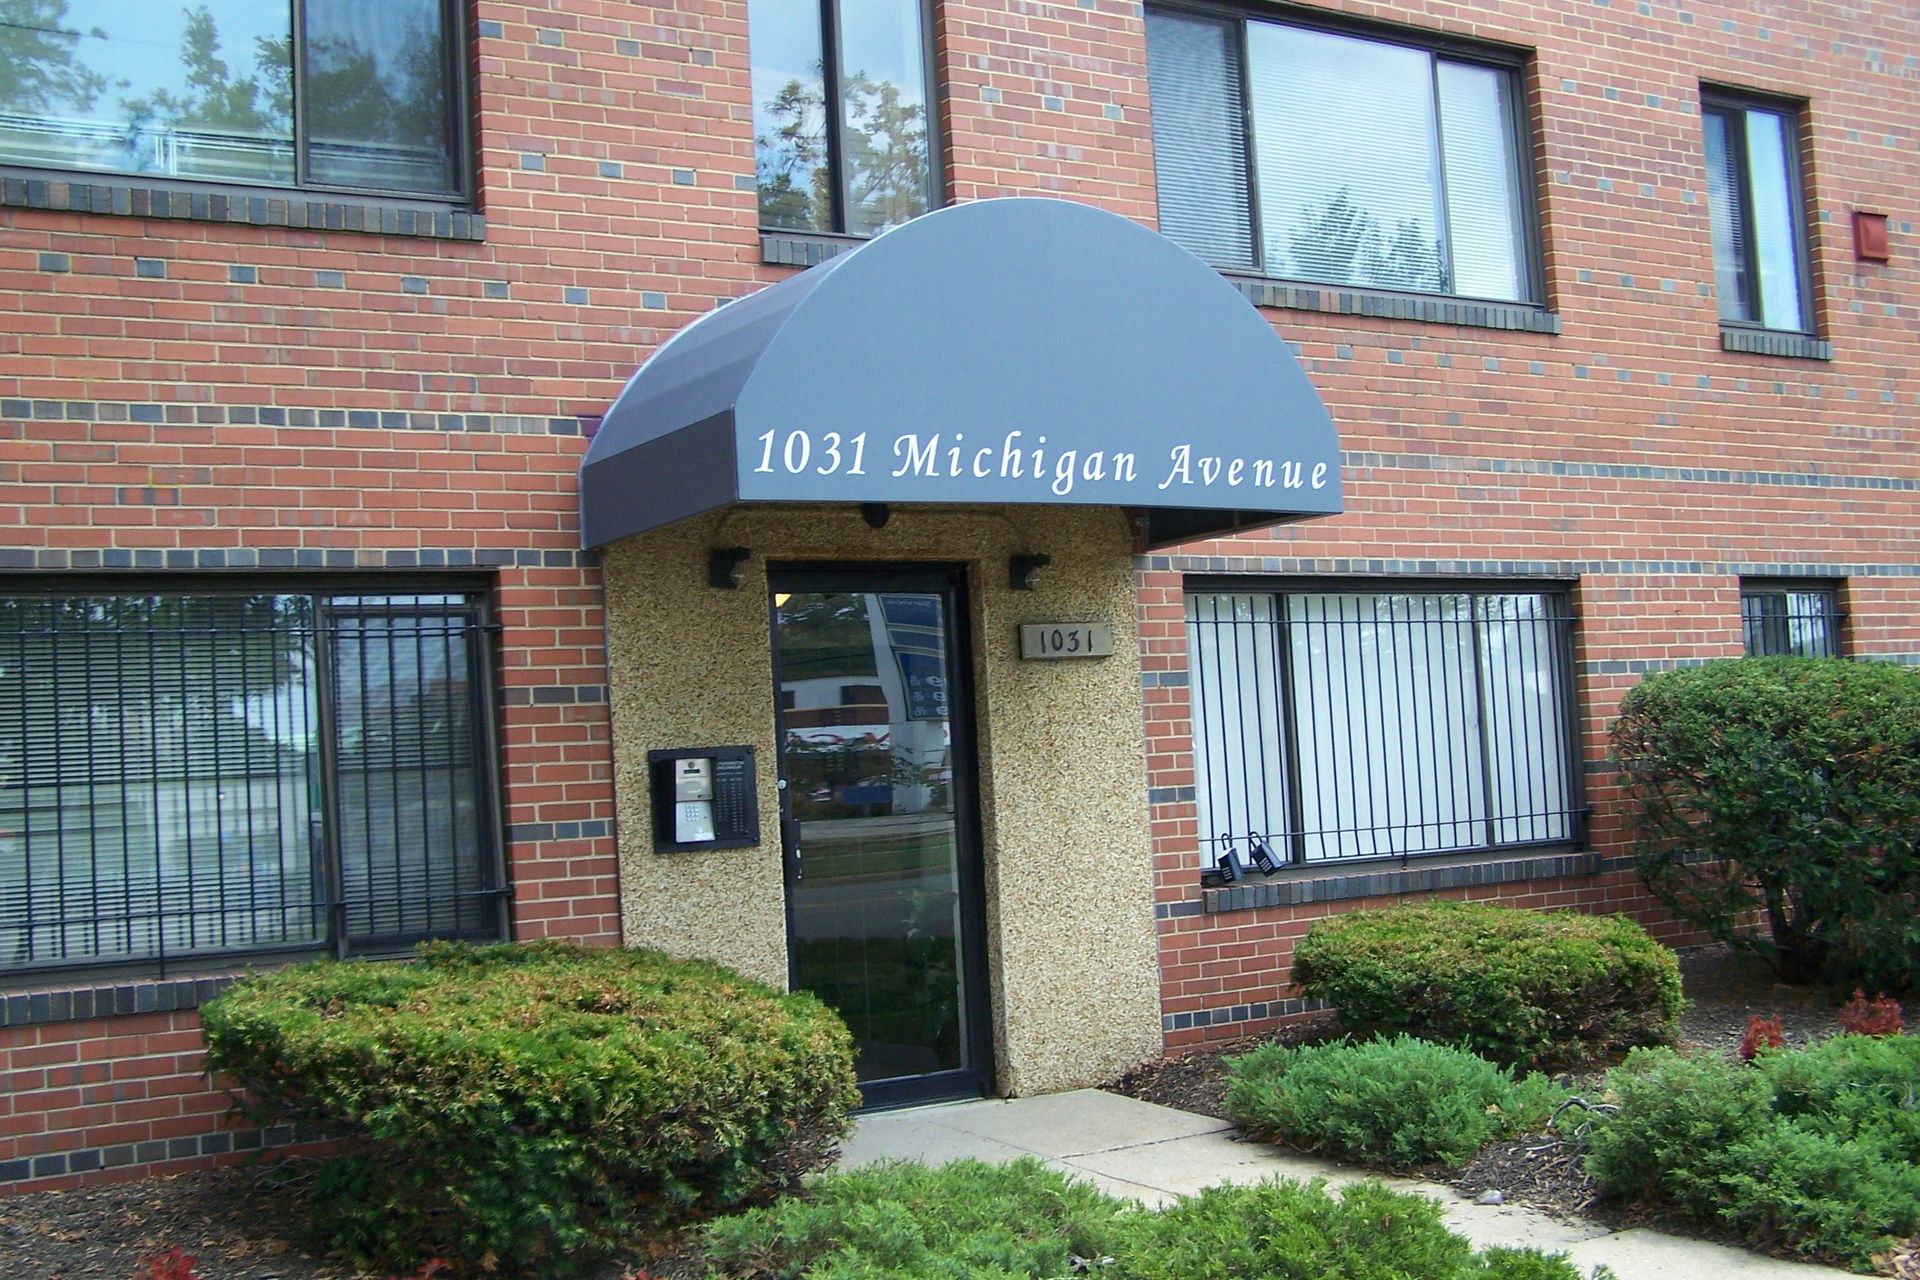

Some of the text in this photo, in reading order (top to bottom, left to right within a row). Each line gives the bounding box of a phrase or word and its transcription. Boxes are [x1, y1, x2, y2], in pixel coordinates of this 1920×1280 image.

[753, 429, 1327, 495] 1031 Michigan Avenue
[1041, 629, 1093, 653] 1031
